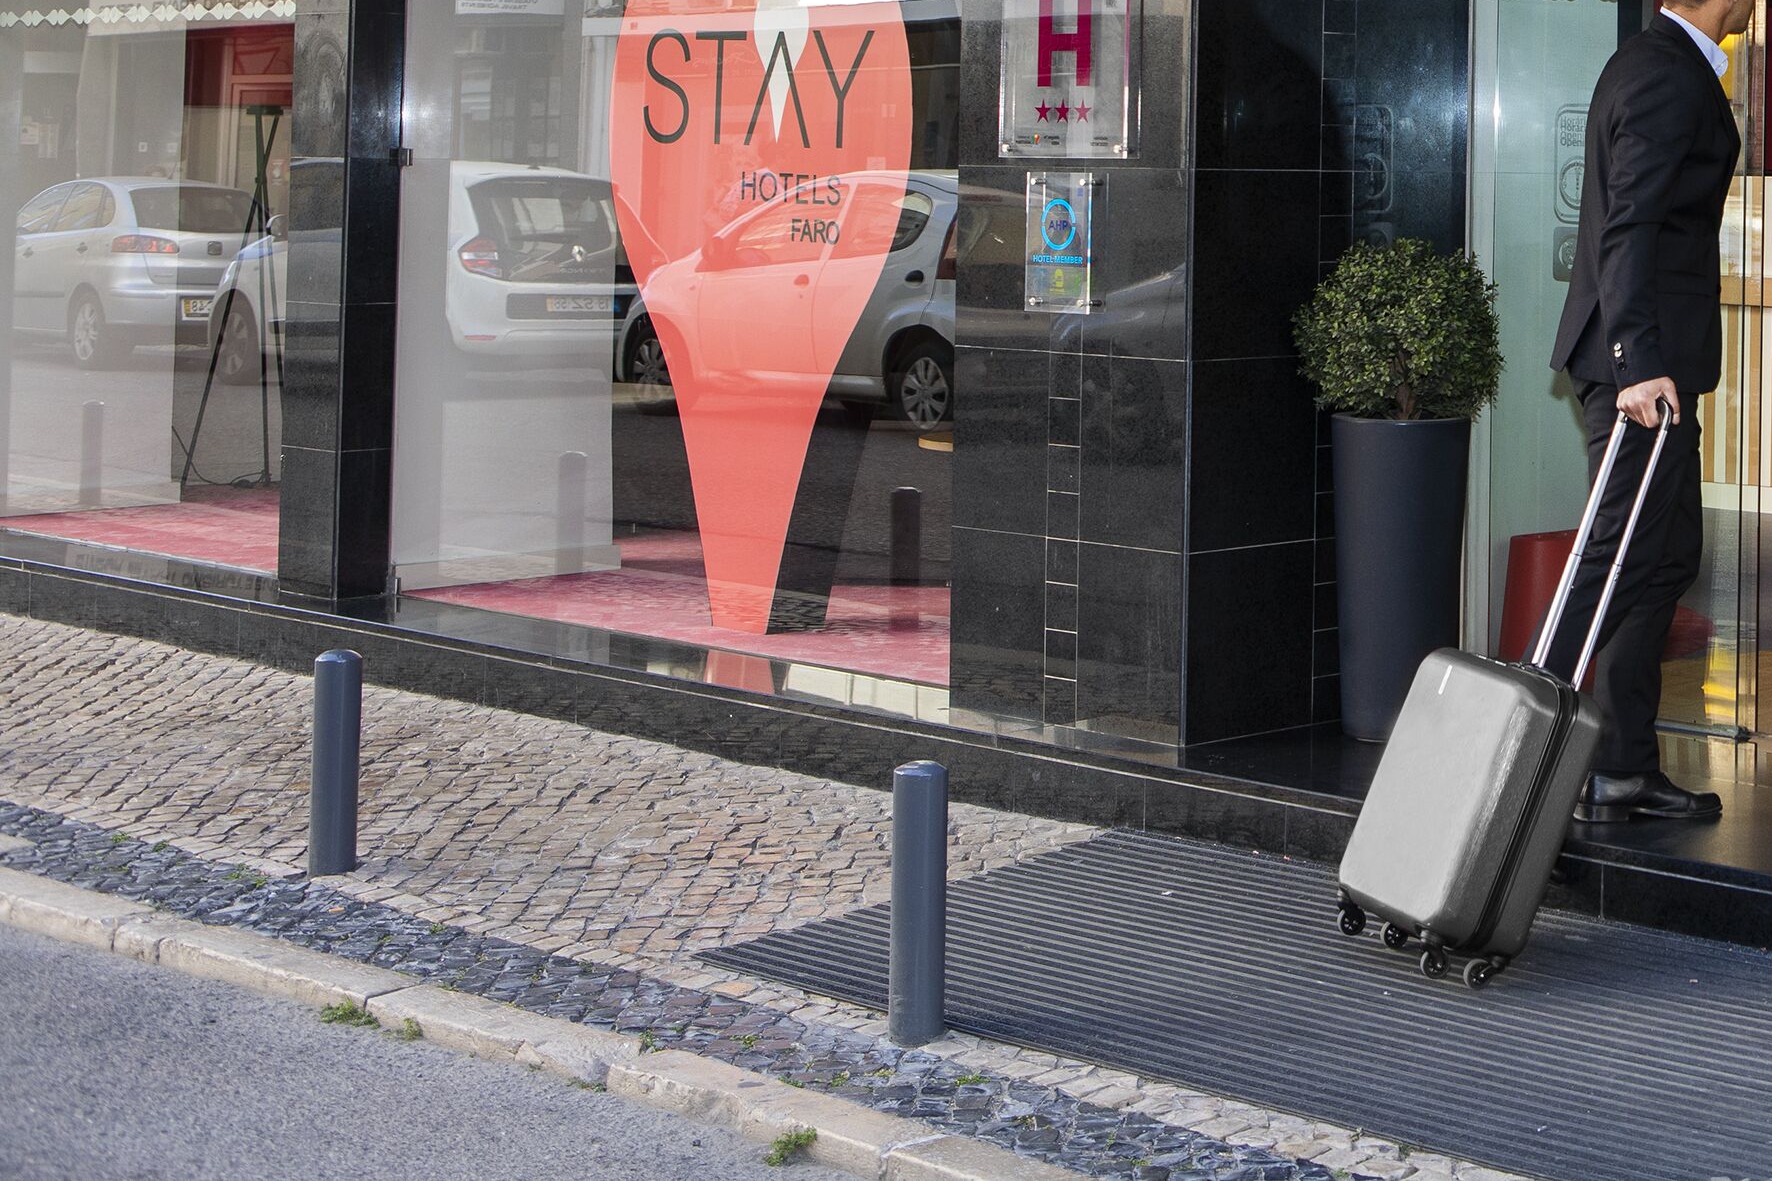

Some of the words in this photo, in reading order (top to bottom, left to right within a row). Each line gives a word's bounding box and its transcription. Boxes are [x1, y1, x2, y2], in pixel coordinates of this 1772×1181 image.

[643, 29, 875, 149] STAY
[741, 172, 841, 206] HOTELS
[790, 218, 840, 245] FARO
[1048, 219, 1069, 231] AHP
[1032, 255, 1053, 264] HOTEL
[1054, 255, 1083, 264] MEMBER
